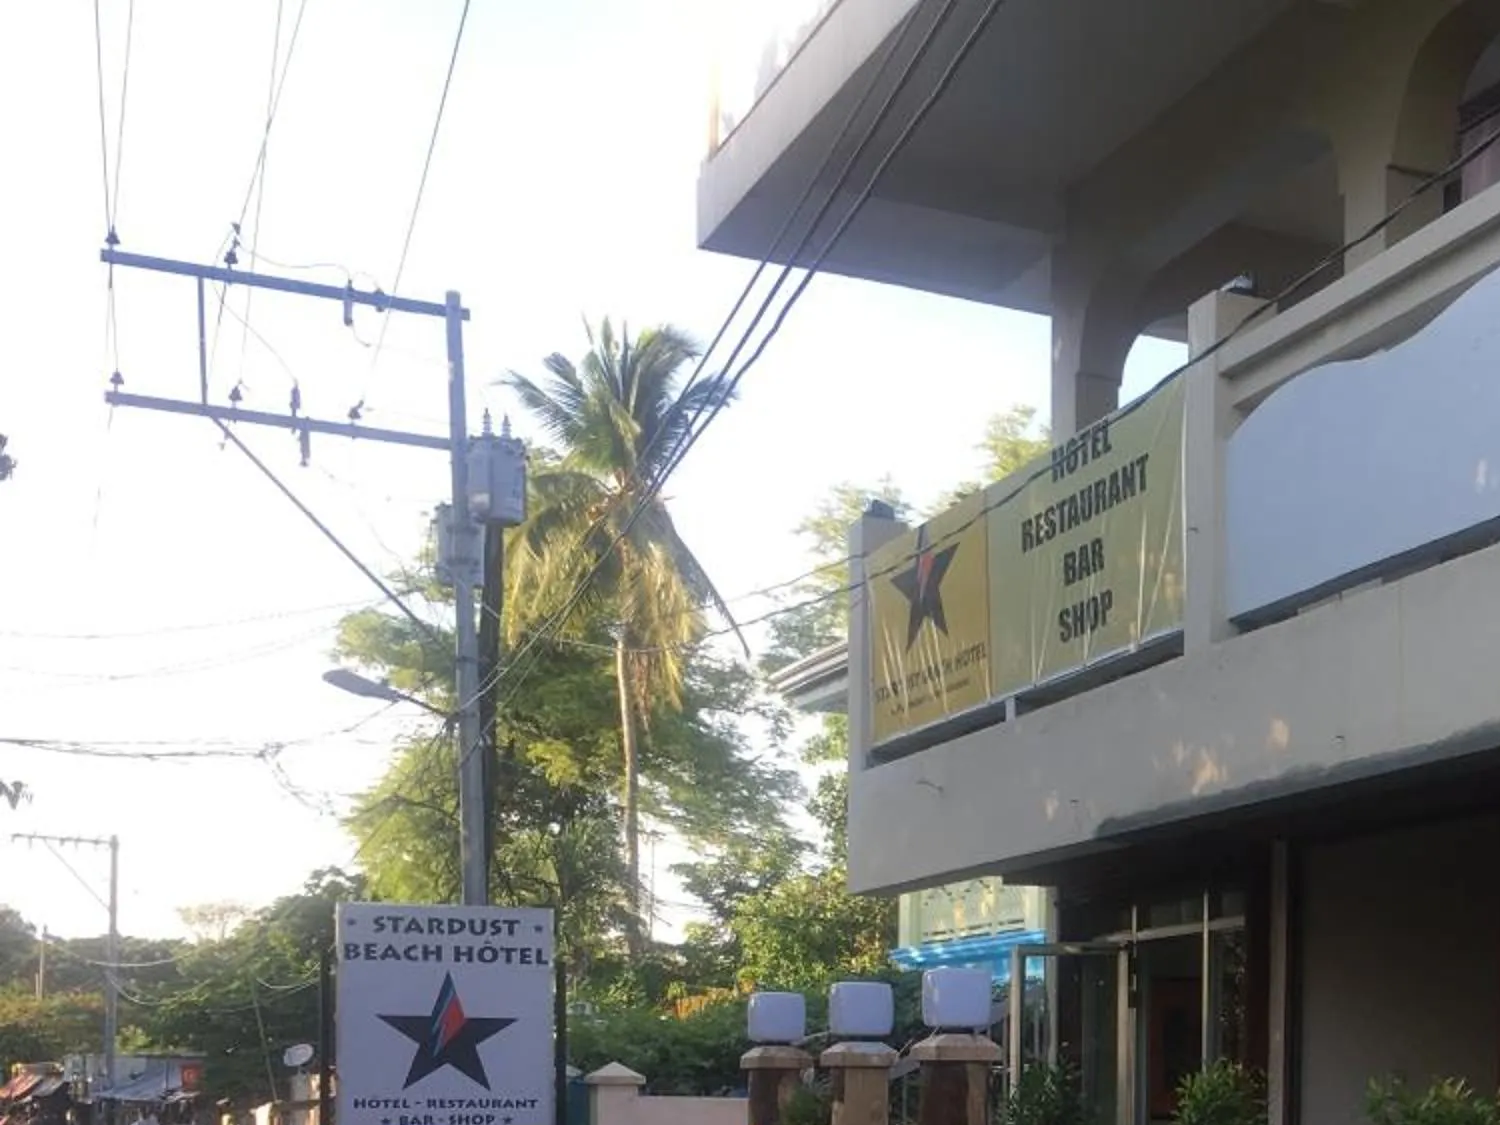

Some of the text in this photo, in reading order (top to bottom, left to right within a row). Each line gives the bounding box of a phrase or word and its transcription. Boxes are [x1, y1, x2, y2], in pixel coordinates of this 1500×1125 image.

[1051, 418, 1112, 483] HOTEL
[1021, 452, 1149, 553] RESTAURANT
[1063, 538, 1104, 586] BAR
[1059, 589, 1112, 643] SHOP
[372, 915, 521, 936] STARDUST
[343, 942, 443, 963] BEACH
[427, 1098, 539, 1110] RESTAURANT
